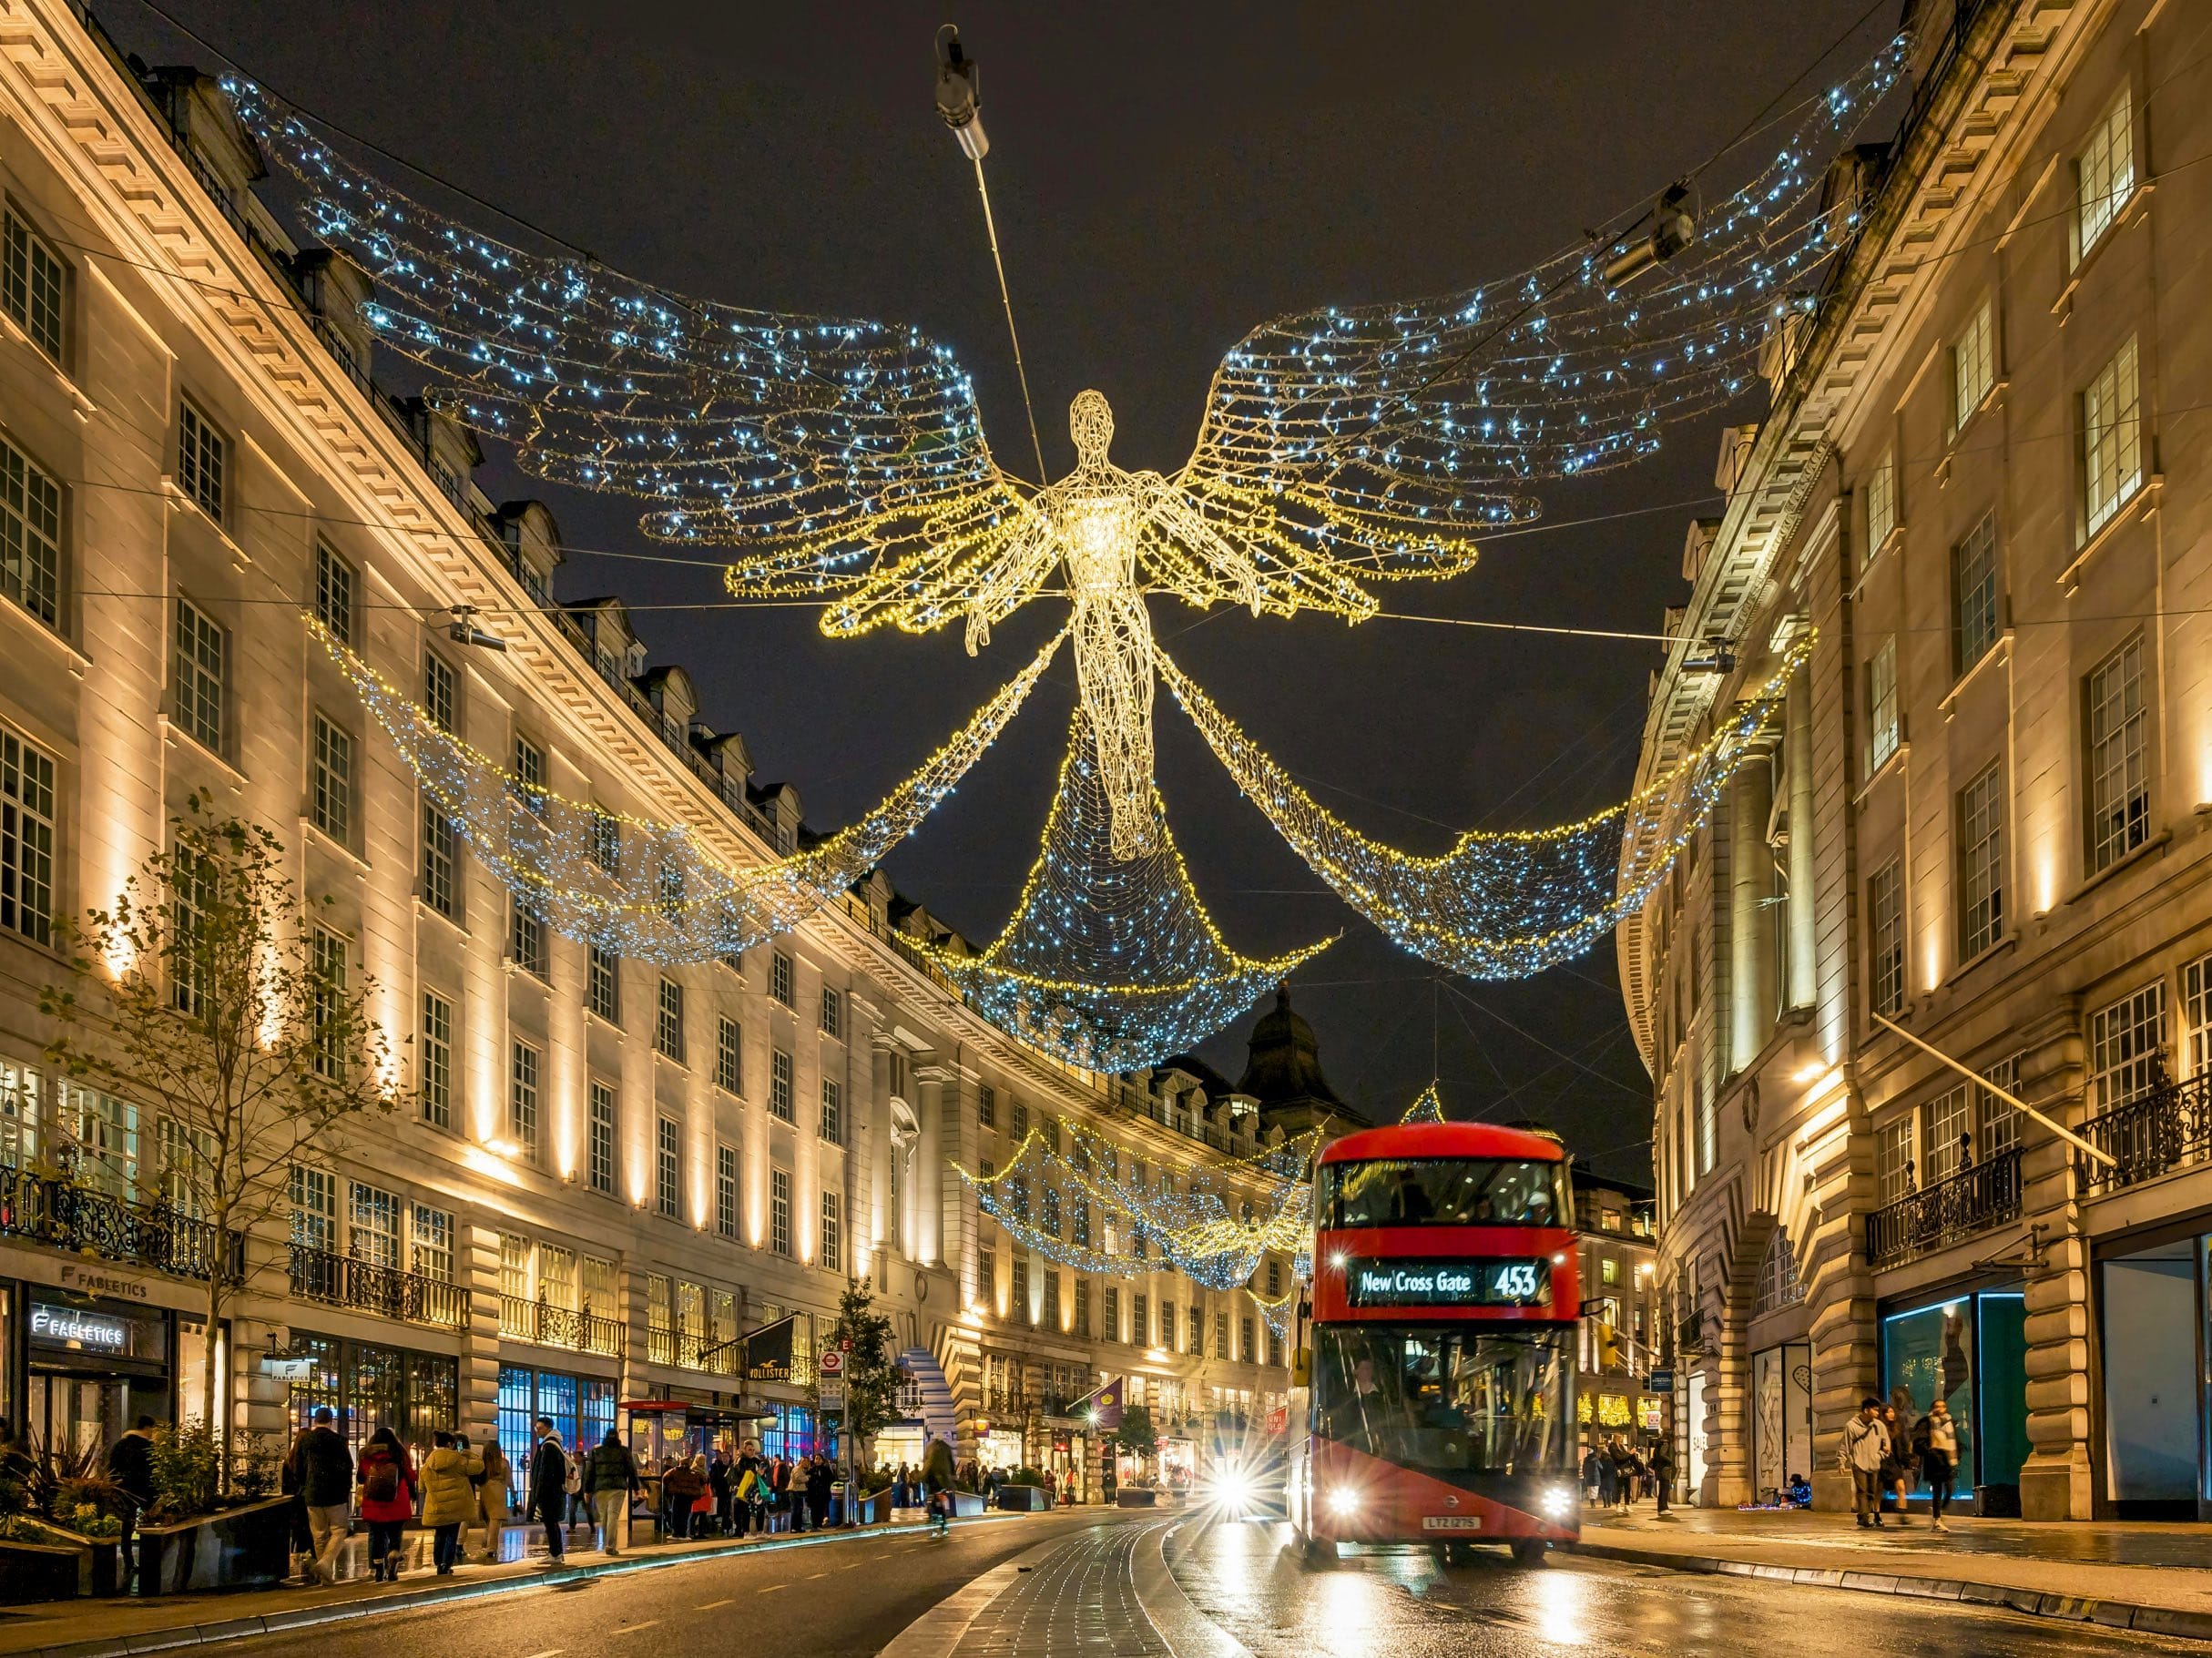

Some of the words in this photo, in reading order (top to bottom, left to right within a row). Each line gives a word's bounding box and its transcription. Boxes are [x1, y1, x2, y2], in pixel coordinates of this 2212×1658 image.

[78, 1274, 148, 1298] FABLETICS
[1362, 1272, 1391, 1292] New
[1395, 1271, 1434, 1292] Cross
[1436, 1271, 1472, 1292] Gate
[1494, 1266, 1536, 1297] 453
[49, 1319, 123, 1345] FABLETICS
[842, 1340, 850, 1350] E
[749, 1368, 790, 1378] HOLLISTER
[1269, 1415, 1281, 1423] UNI
